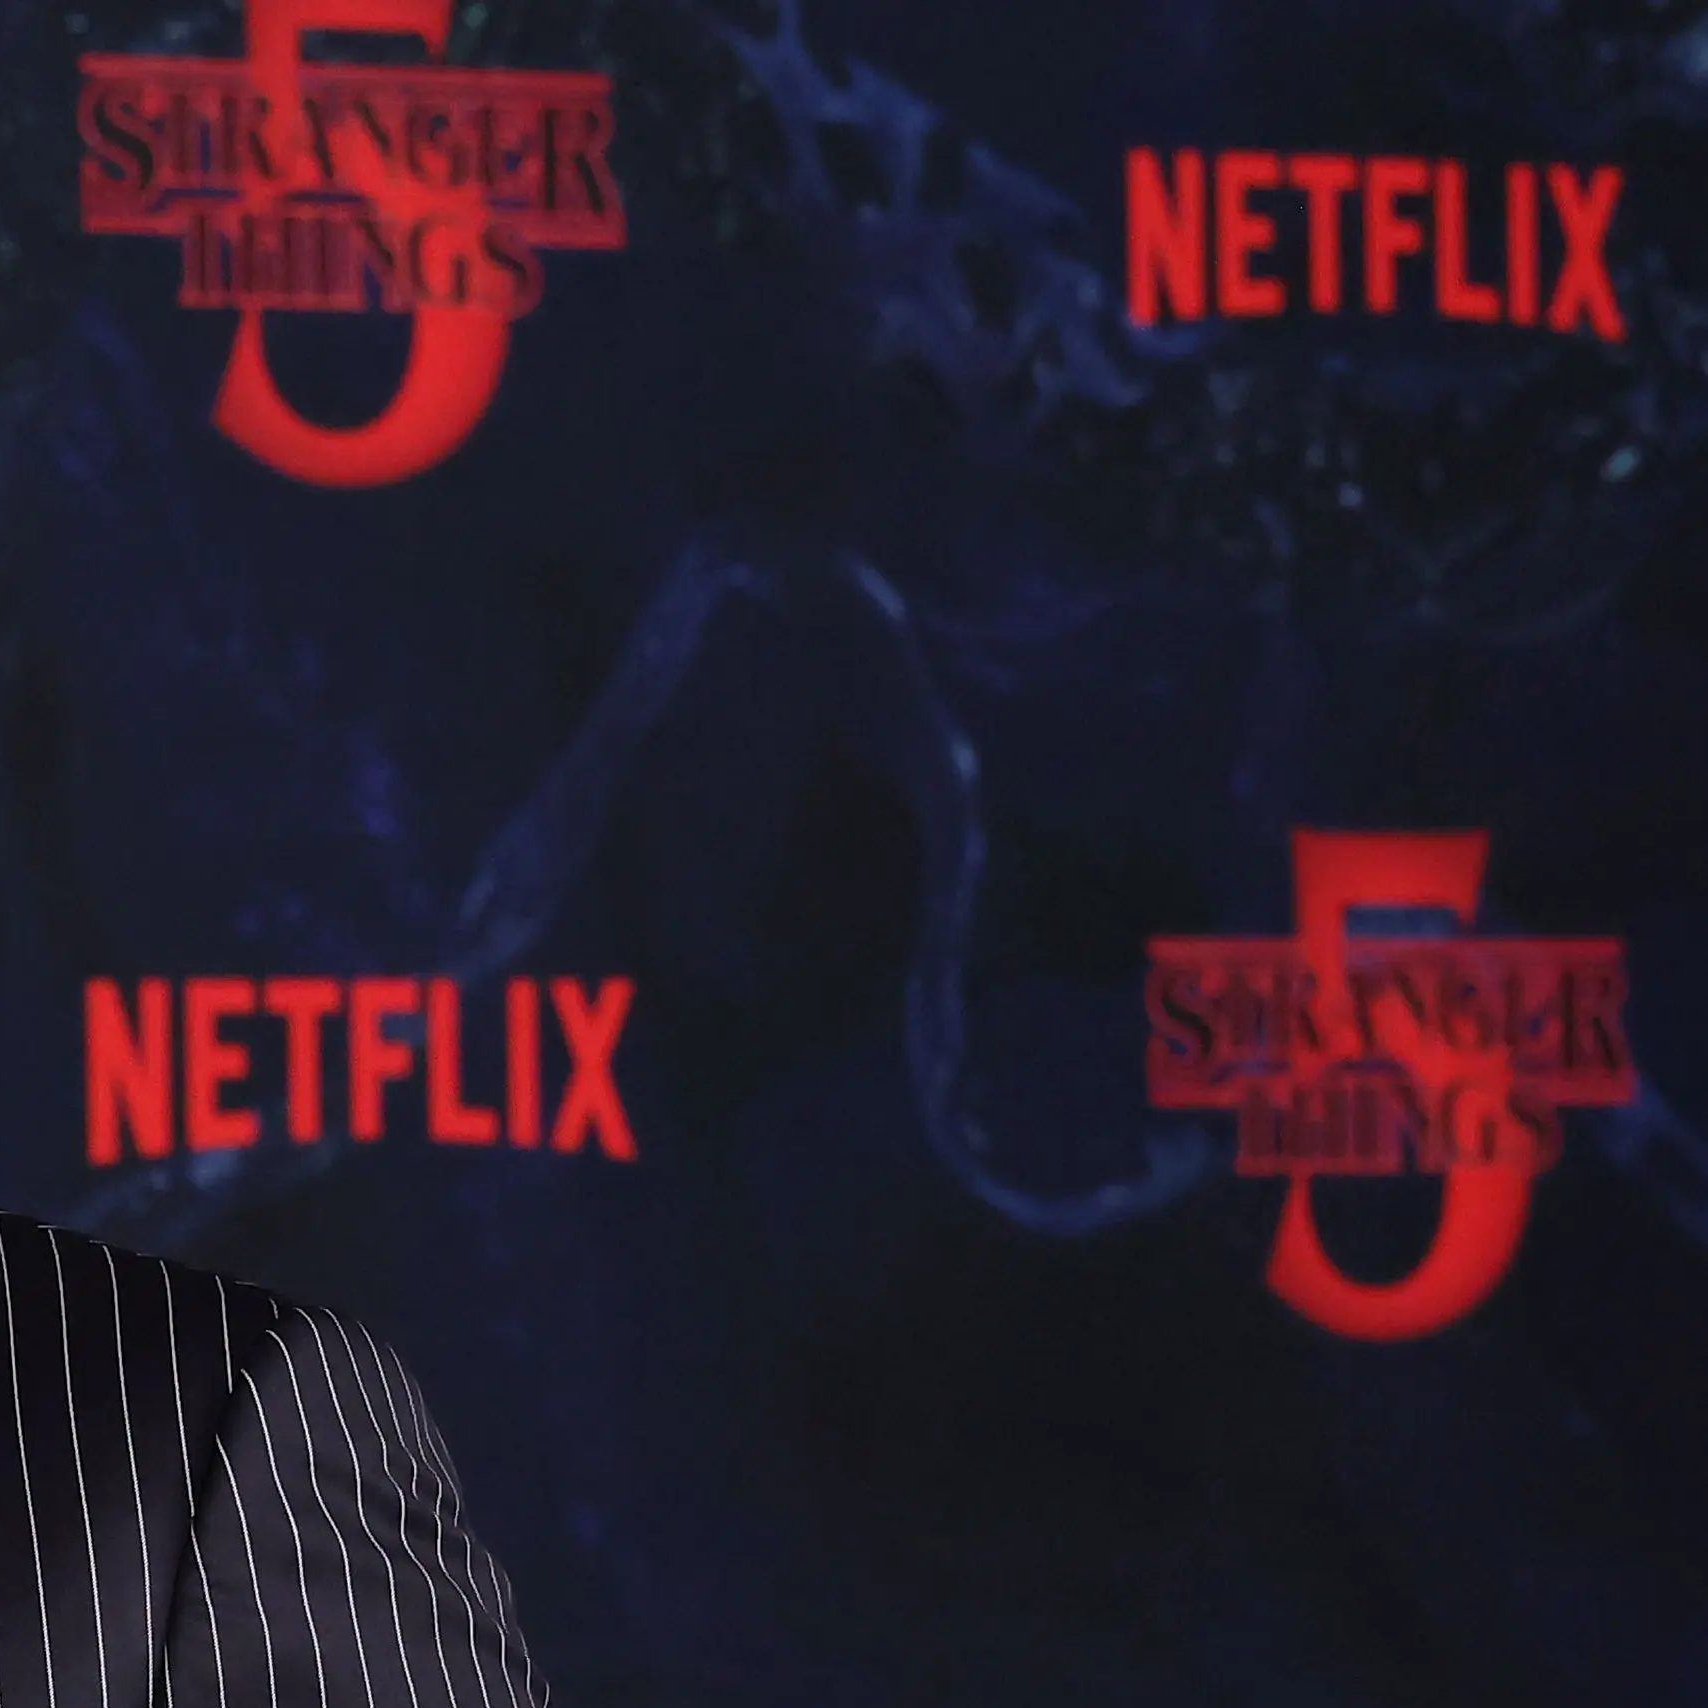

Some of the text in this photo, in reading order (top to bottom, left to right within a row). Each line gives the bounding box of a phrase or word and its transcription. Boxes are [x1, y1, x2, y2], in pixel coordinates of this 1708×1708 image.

[79, 53, 627, 248] STRANGER
[211, 0, 511, 488] 5
[1125, 146, 1627, 342] NETFLIX
[178, 212, 545, 320] THINGS
[85, 974, 638, 1168] NETFLIX
[1146, 936, 1638, 1108] STRANGER
[1267, 827, 1534, 1341] 5
[1235, 1075, 1563, 1176] THINGS
